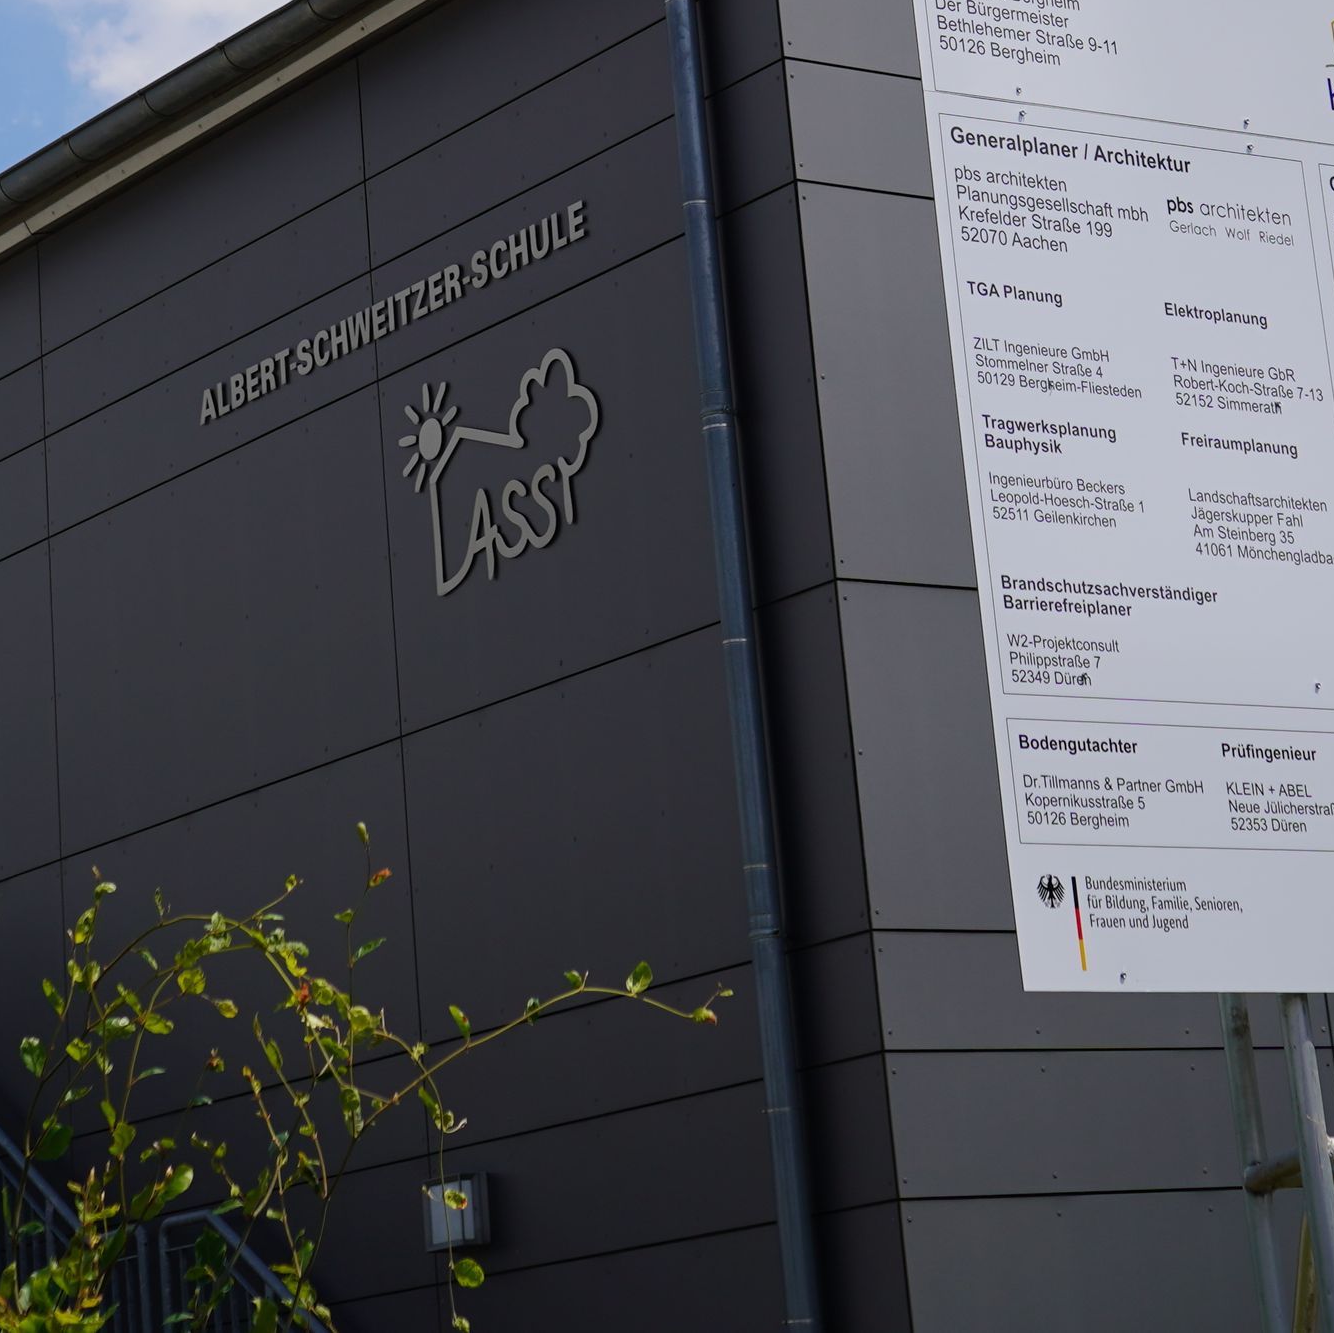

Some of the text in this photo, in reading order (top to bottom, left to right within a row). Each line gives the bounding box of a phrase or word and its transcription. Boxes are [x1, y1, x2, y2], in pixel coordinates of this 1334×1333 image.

[966, 0, 1069, 28] Bürgermeister
[937, 14, 1117, 55] Bethlehemer Straße 9-11
[939, 34, 1061, 66] 50126 Bergheim
[950, 126, 1191, 173] Generalplaner Architektur
[954, 165, 1067, 192] pbs architekten
[956, 184, 1149, 222] Planungsgesellschaft mbh
[1166, 196, 1292, 226] pbs architekten
[958, 205, 1113, 238] Krefelder Straße 199
[1169, 220, 1294, 246] Gerlach Wolf Riedel
[961, 225, 1068, 253] 52070 Aachen
[966, 280, 1063, 308] TGA Planung
[200, 200, 587, 426] ALBERT-SCHWEITZER-SCHULE
[1164, 302, 1268, 330] Elektroplanung
[973, 336, 1110, 362] ZILT Ingenieure GmbH
[975, 353, 1103, 378] Stommelner Straße 4
[1170, 356, 1296, 382] T+N Ingenieure GbR
[977, 370, 1015, 387] 50129
[1173, 374, 1324, 402] Robert-Koch-Straße 7-13
[1175, 392, 1214, 408] 52152
[981, 414, 1117, 443] Tragwerksplanung
[984, 433, 1063, 456] Bauphysik
[1181, 432, 1298, 460] Freiraumplanung
[988, 471, 1125, 495] Ingenieurbüro Beckers
[990, 488, 1135, 512] Leopold-Hoesch-Straße
[1188, 488, 1328, 512] Landschaftsarchitekten
[992, 506, 1117, 528] 52511 Geilenkirchen
[1191, 506, 1304, 528] Jägerskupper Fahl
[1193, 524, 1295, 547] Am Steinberg 35
[1195, 542, 1232, 557] 41061
[1000, 574, 1218, 606] Brandschutzsachverständiger
[1003, 594, 1132, 618] Barrierefreiplaner
[1006, 633, 1120, 653] W2-Projektconsult
[1009, 651, 1101, 670] Philippstraße 7
[1011, 669, 1051, 685] 52349
[1018, 734, 1138, 755] Bodengutachter
[1221, 742, 1317, 764] Prüfingenieur
[1022, 774, 1204, 794] Dr.Tillmanns Partner GmbH
[1226, 781, 1312, 798] KLEIN ABEL
[1024, 792, 1146, 810] Kopernikusstraße 5
[1228, 799, 1260, 814] Neue
[1027, 810, 1130, 830] 50126 Bergheim
[1231, 817, 1307, 833] 52353 Düren
[1085, 876, 1187, 892] Bundesministerium
[1087, 894, 1243, 913] für Bildung, Familie, Senioren,
[1089, 912, 1189, 933] Frauen und Jugend
